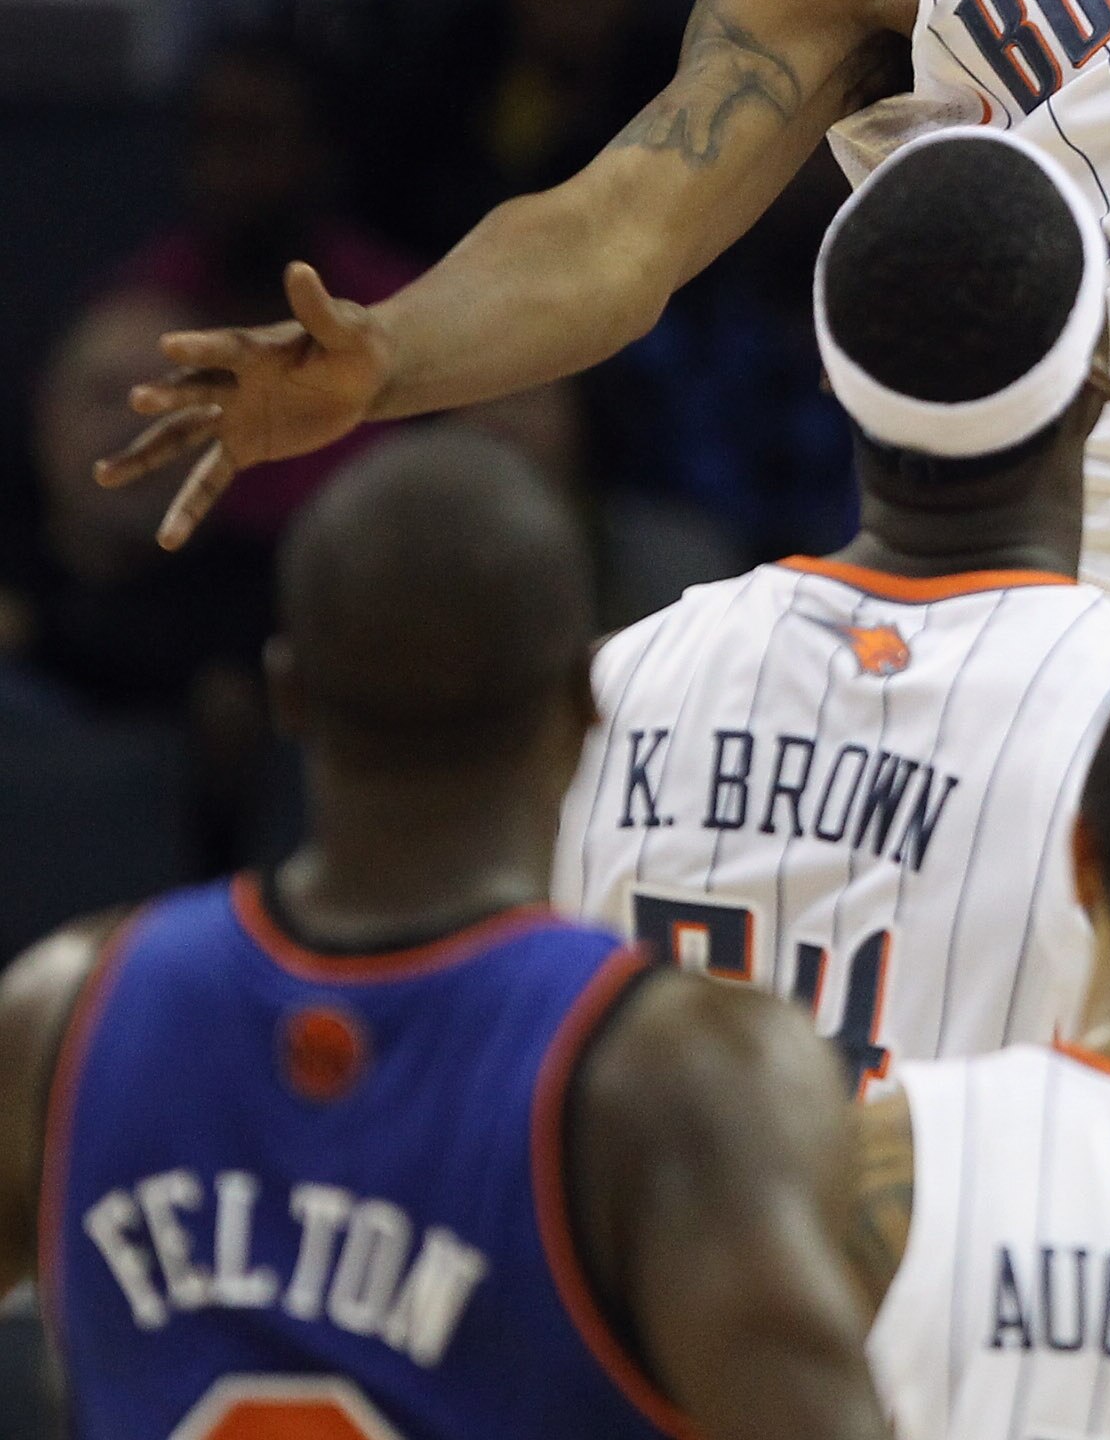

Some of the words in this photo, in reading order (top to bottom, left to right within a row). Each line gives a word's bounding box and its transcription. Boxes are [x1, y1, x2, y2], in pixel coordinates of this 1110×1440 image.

[619, 729, 673, 828] K.
[704, 729, 960, 873] BROWN
[82, 1166, 490, 1369] FELTON
